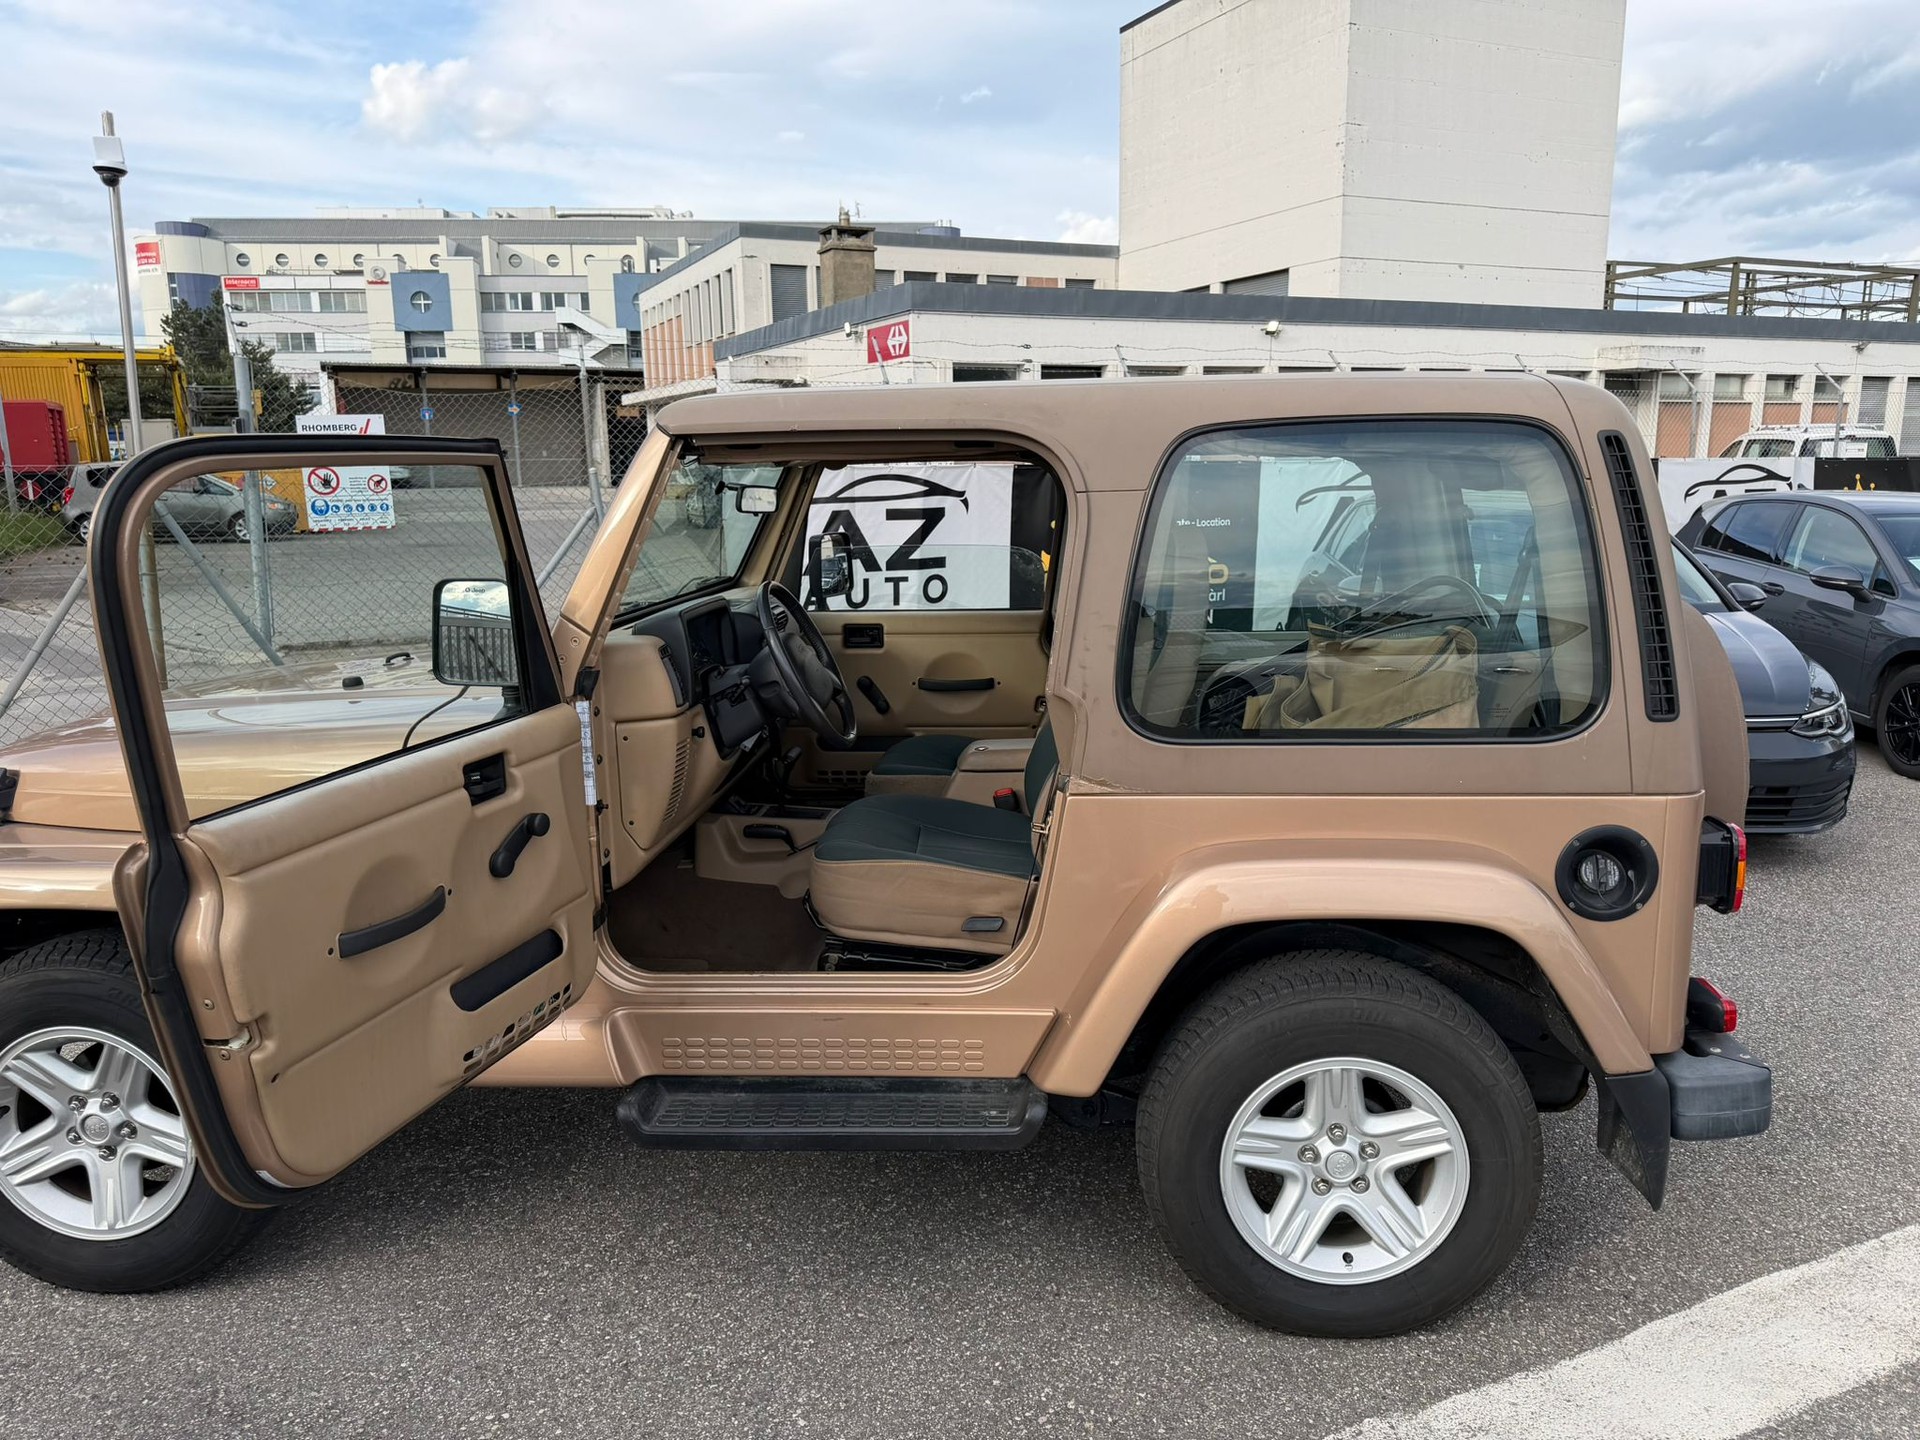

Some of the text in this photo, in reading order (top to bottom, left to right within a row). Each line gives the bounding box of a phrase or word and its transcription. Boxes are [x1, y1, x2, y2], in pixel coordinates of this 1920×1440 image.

[301, 424, 358, 432] RHOMBERG
[1196, 516, 1231, 527] Location
[802, 507, 947, 573] AZ
[1208, 588, 1226, 602] àrl
